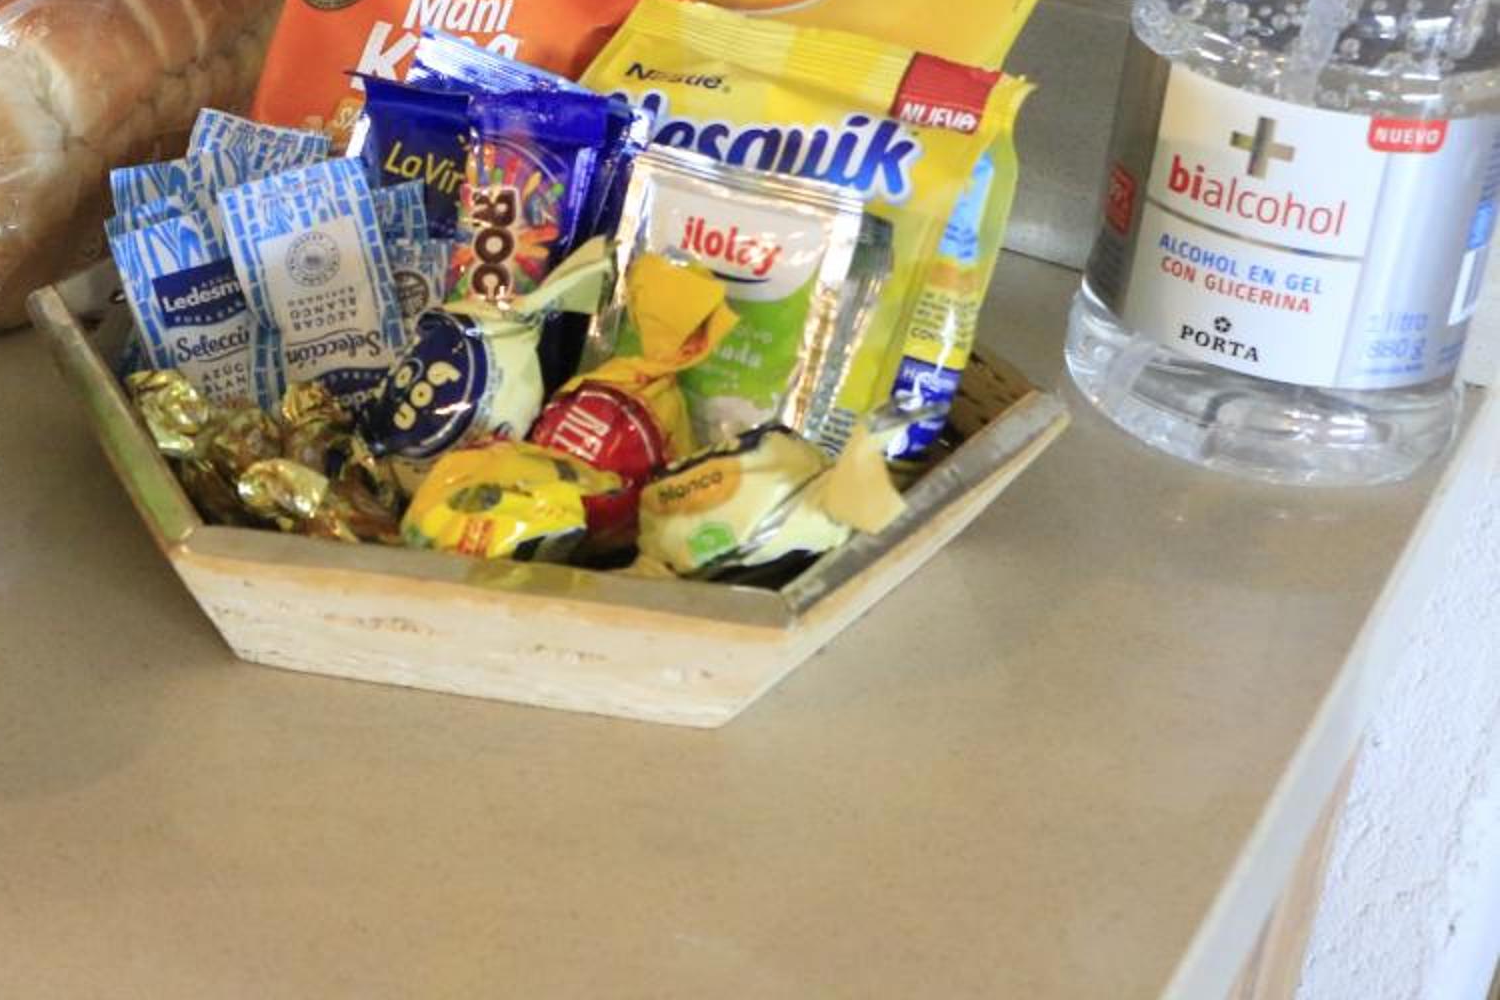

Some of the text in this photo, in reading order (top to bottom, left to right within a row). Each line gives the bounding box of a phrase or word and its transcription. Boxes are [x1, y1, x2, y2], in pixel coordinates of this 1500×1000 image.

[611, 92, 918, 196] esquik
[1374, 125, 1440, 146] NUEVO
[1167, 154, 1348, 238] bialcohol
[1158, 232, 1324, 296] ALCOHOL EN GEL
[1160, 254, 1313, 315] CON GLICERINA
[163, 282, 241, 313] Ledesm
[1178, 324, 1262, 364] PORTA
[202, 361, 244, 382] AZÚC
